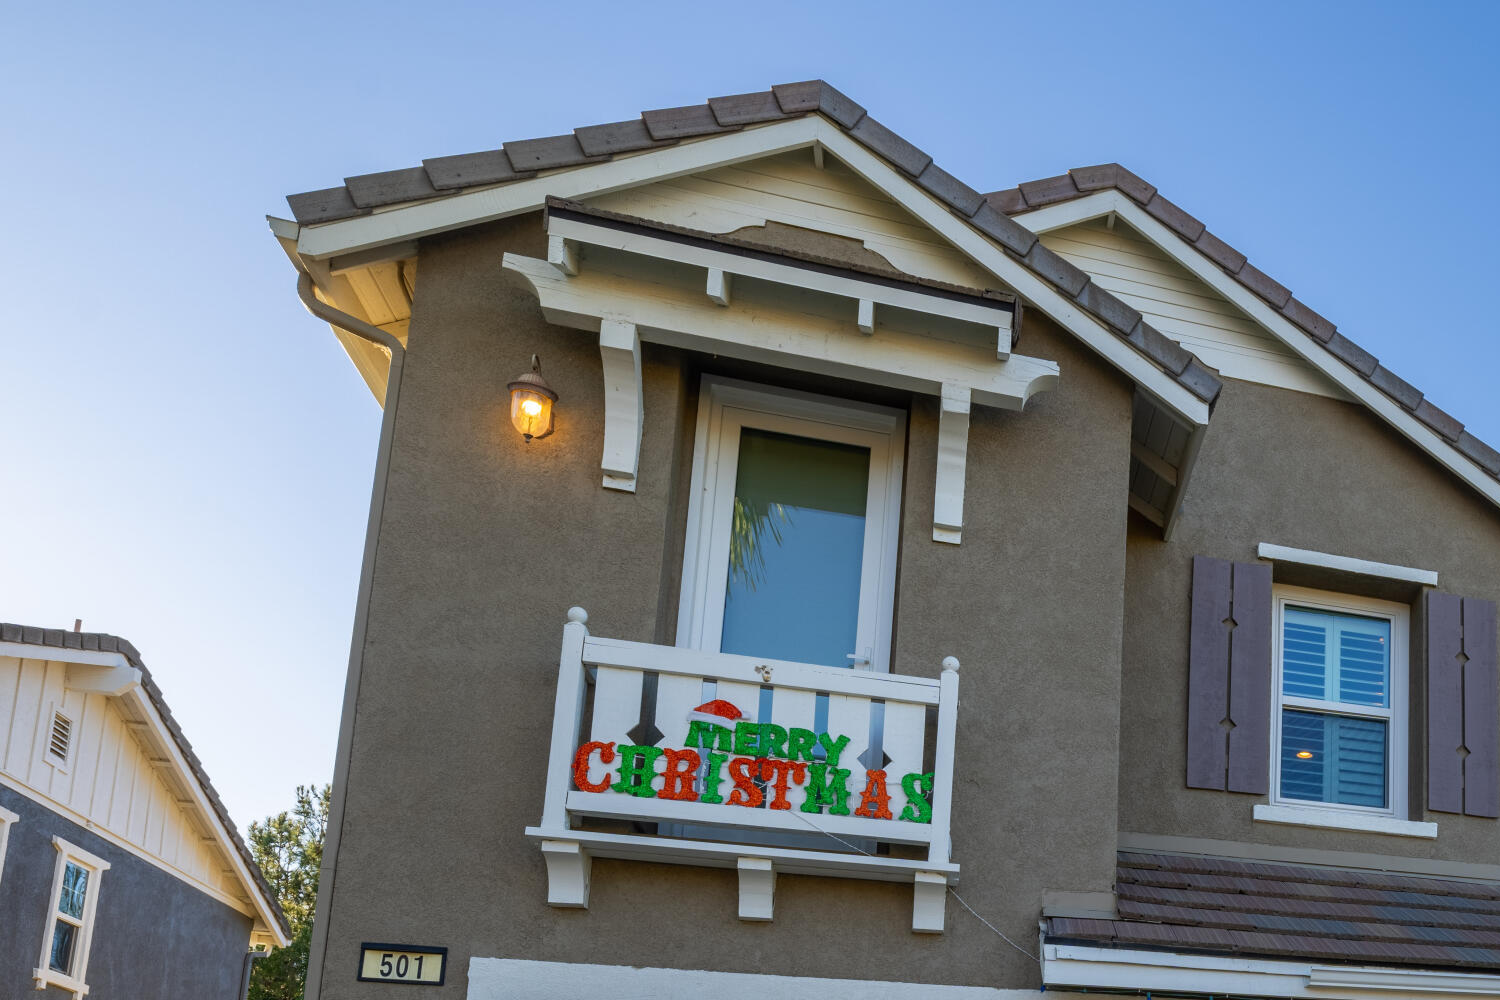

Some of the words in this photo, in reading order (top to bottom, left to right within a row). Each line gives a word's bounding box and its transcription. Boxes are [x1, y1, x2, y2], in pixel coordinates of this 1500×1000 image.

[684, 720, 851, 766] MERRY
[572, 741, 935, 823] CHRISTMAS
[379, 953, 424, 979] 501
